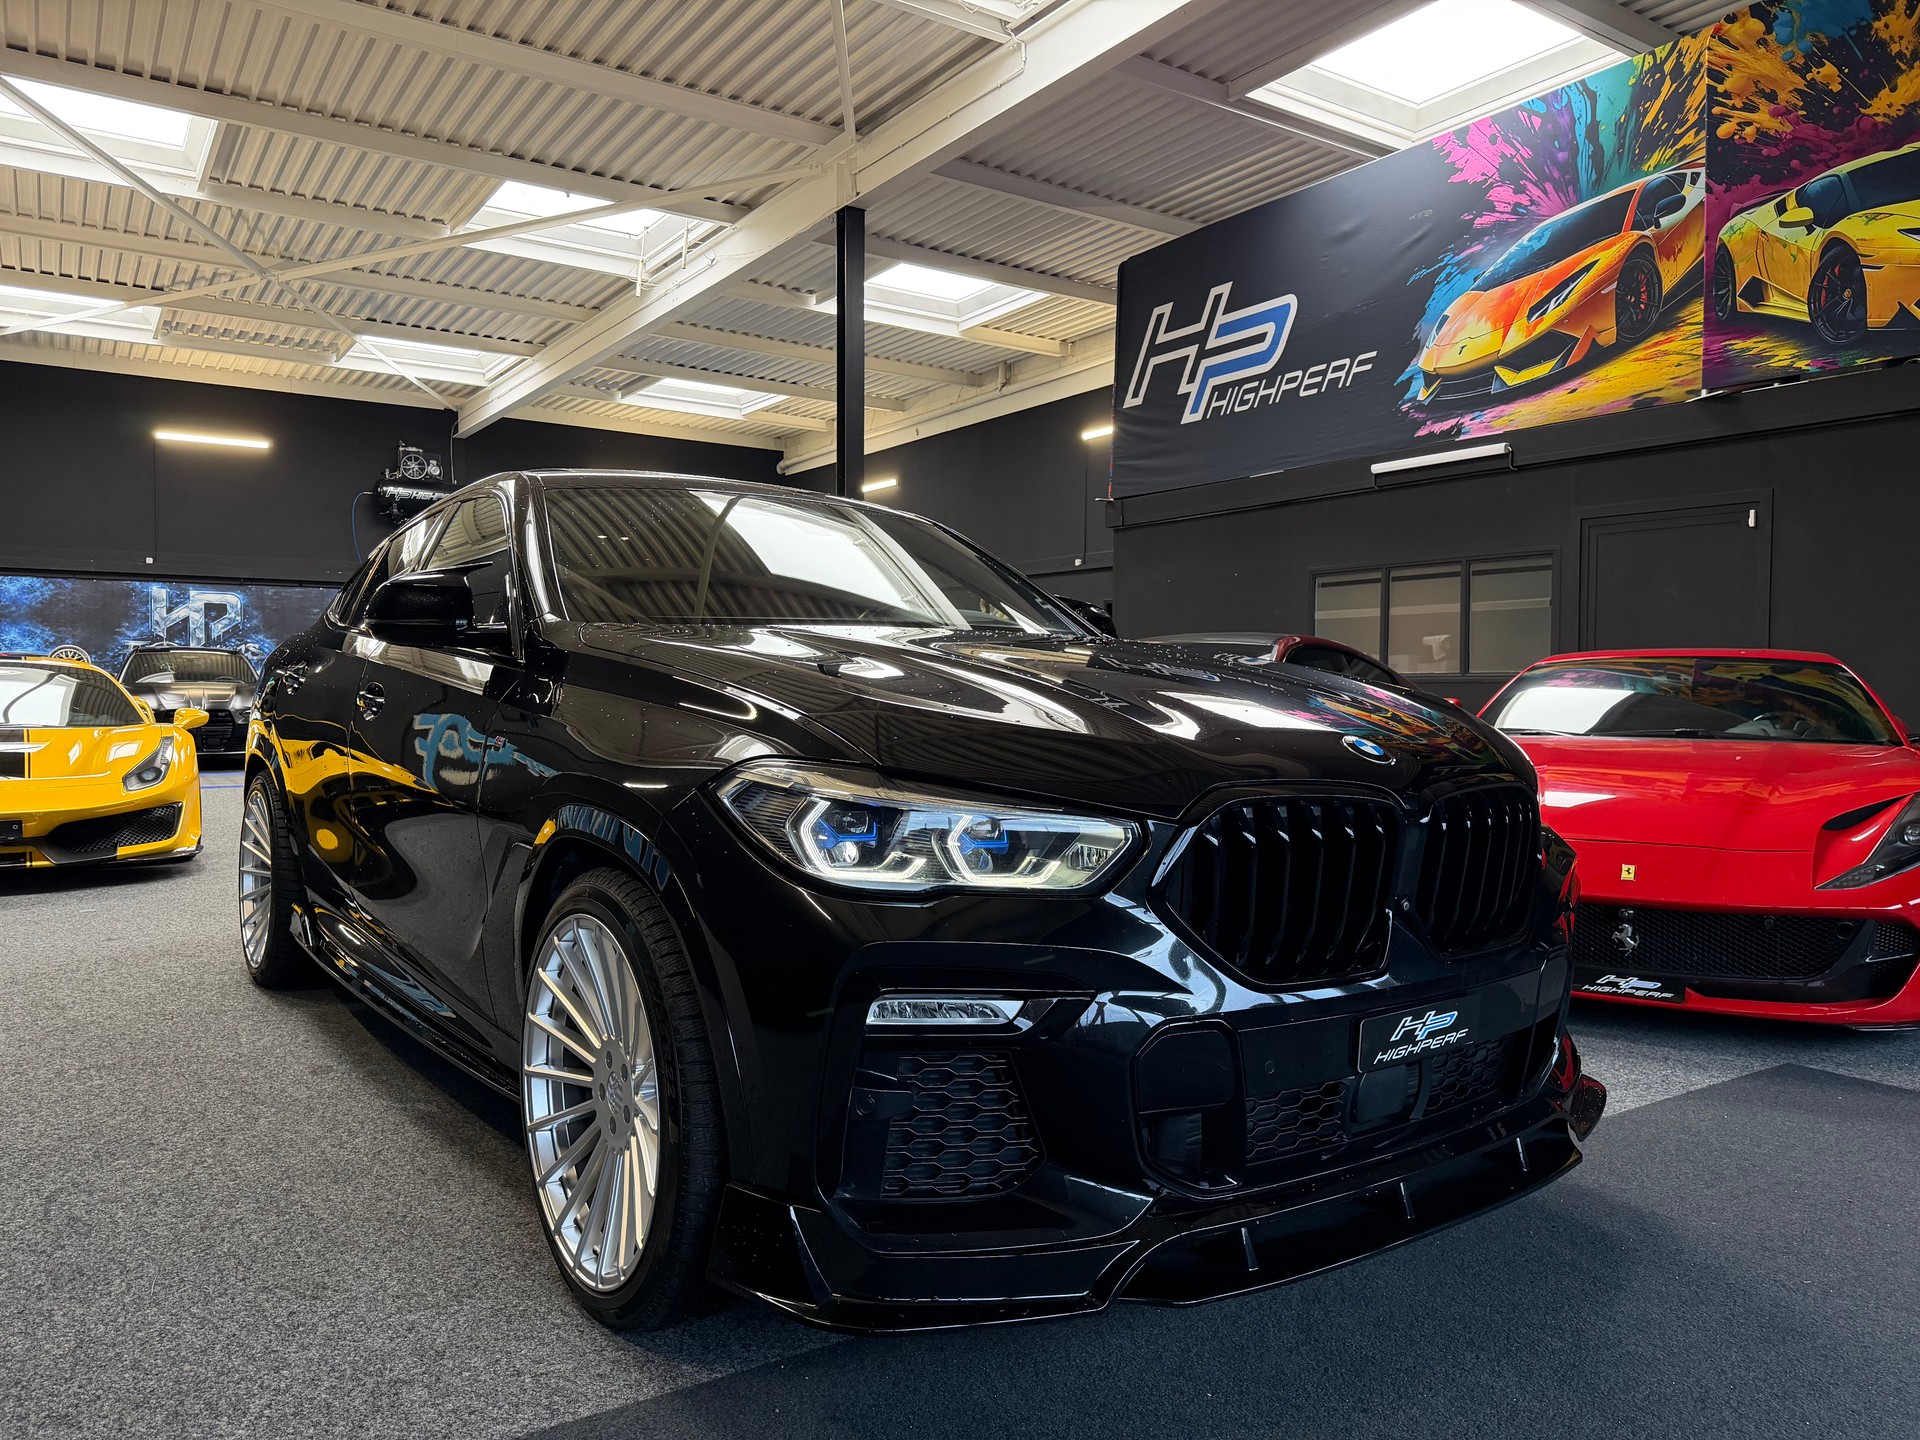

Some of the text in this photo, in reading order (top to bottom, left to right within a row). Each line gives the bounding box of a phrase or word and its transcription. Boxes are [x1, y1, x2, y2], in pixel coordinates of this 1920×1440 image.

[1123, 281, 1298, 425] HP
[1206, 351, 1377, 419] HIGHPERF
[1582, 984, 1675, 999] HIGHPERF
[1390, 1010, 1458, 1042] HP
[1373, 1028, 1469, 1065] HIGHPERF
